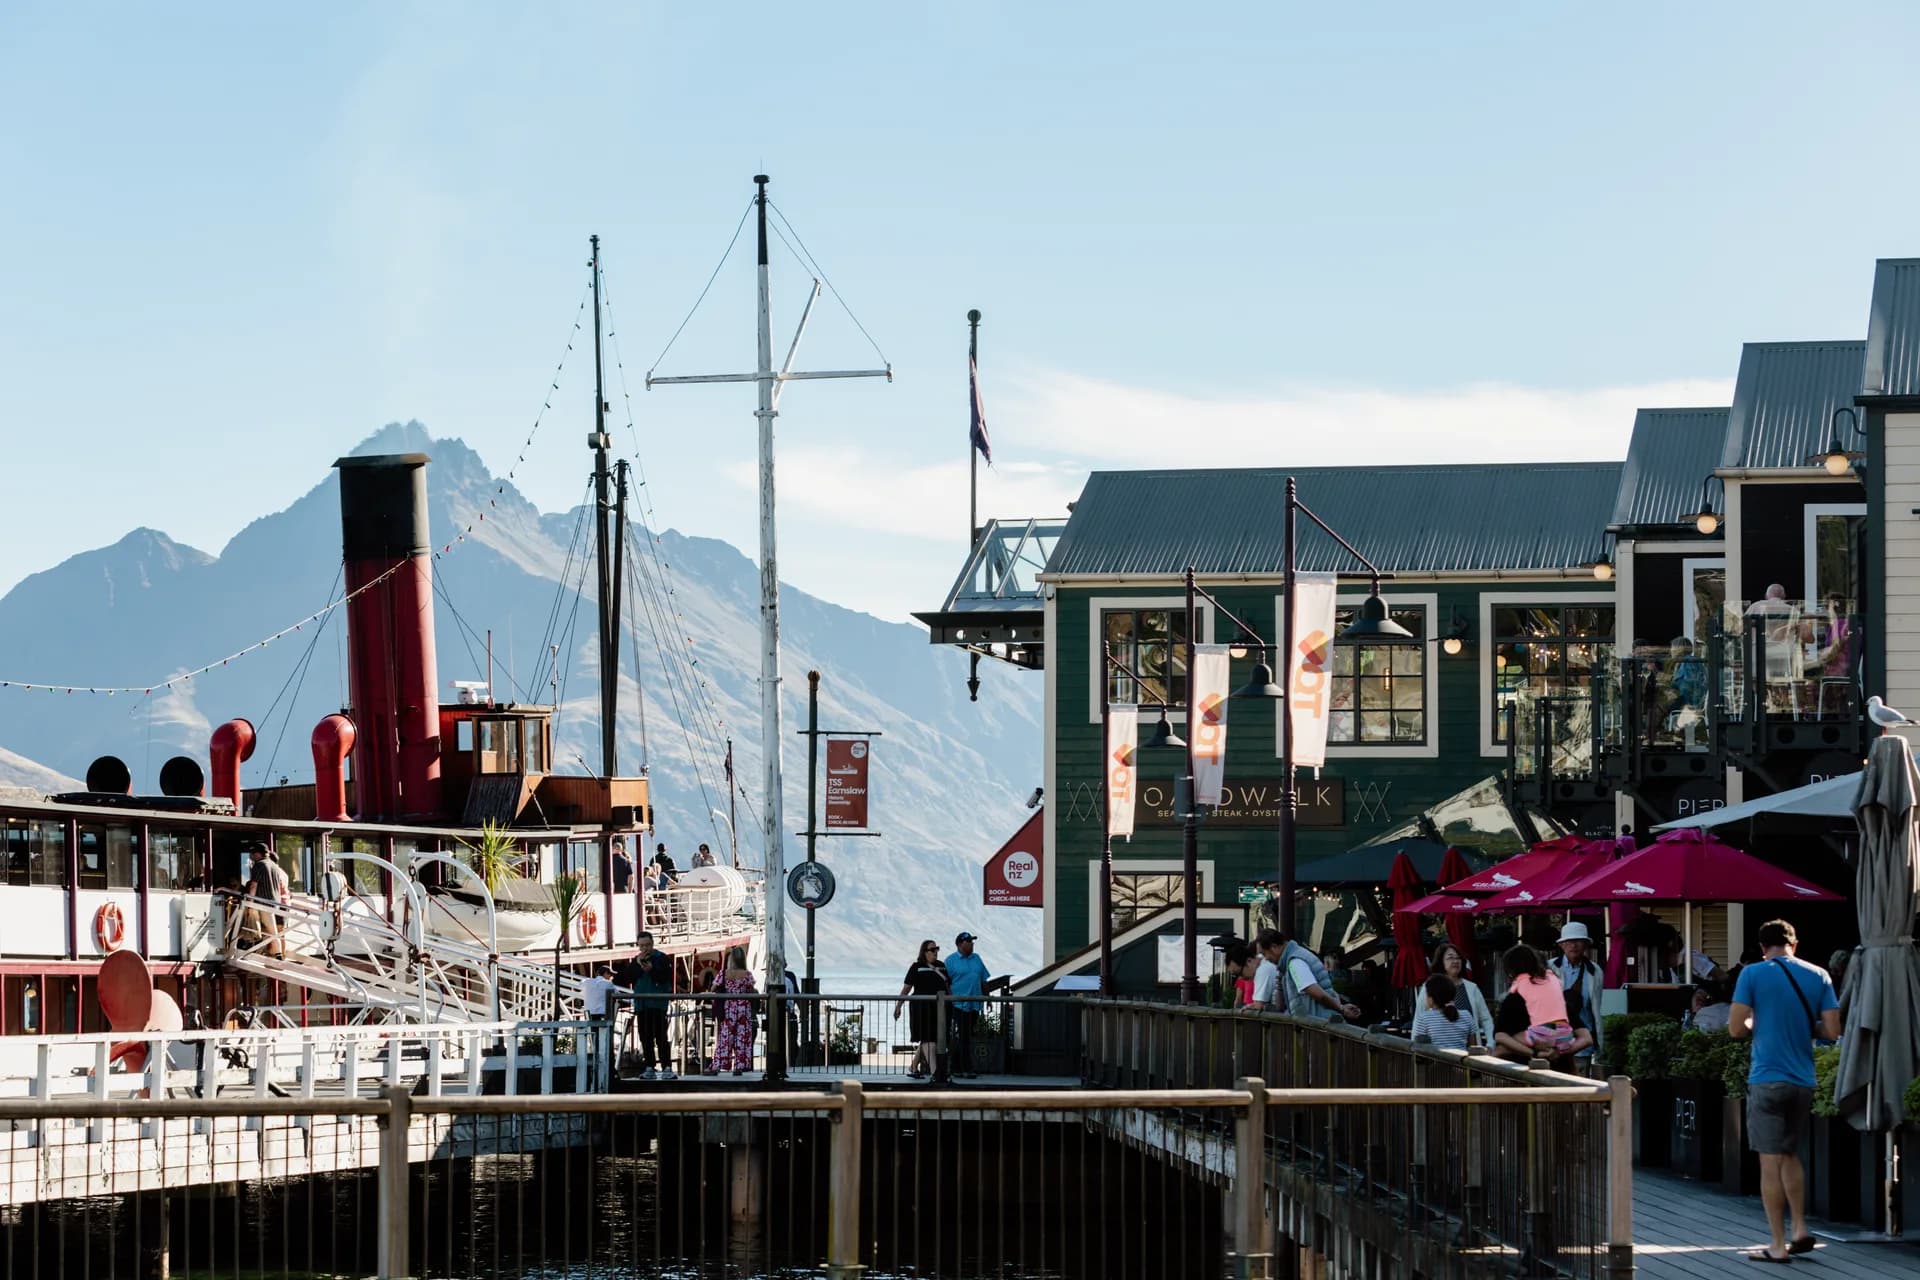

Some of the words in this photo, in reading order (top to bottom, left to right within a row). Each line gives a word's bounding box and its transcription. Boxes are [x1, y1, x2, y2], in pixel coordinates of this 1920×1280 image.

[828, 778, 842, 786] TSS
[828, 786, 865, 795] Earnslaw
[1008, 861, 1033, 871] Real
